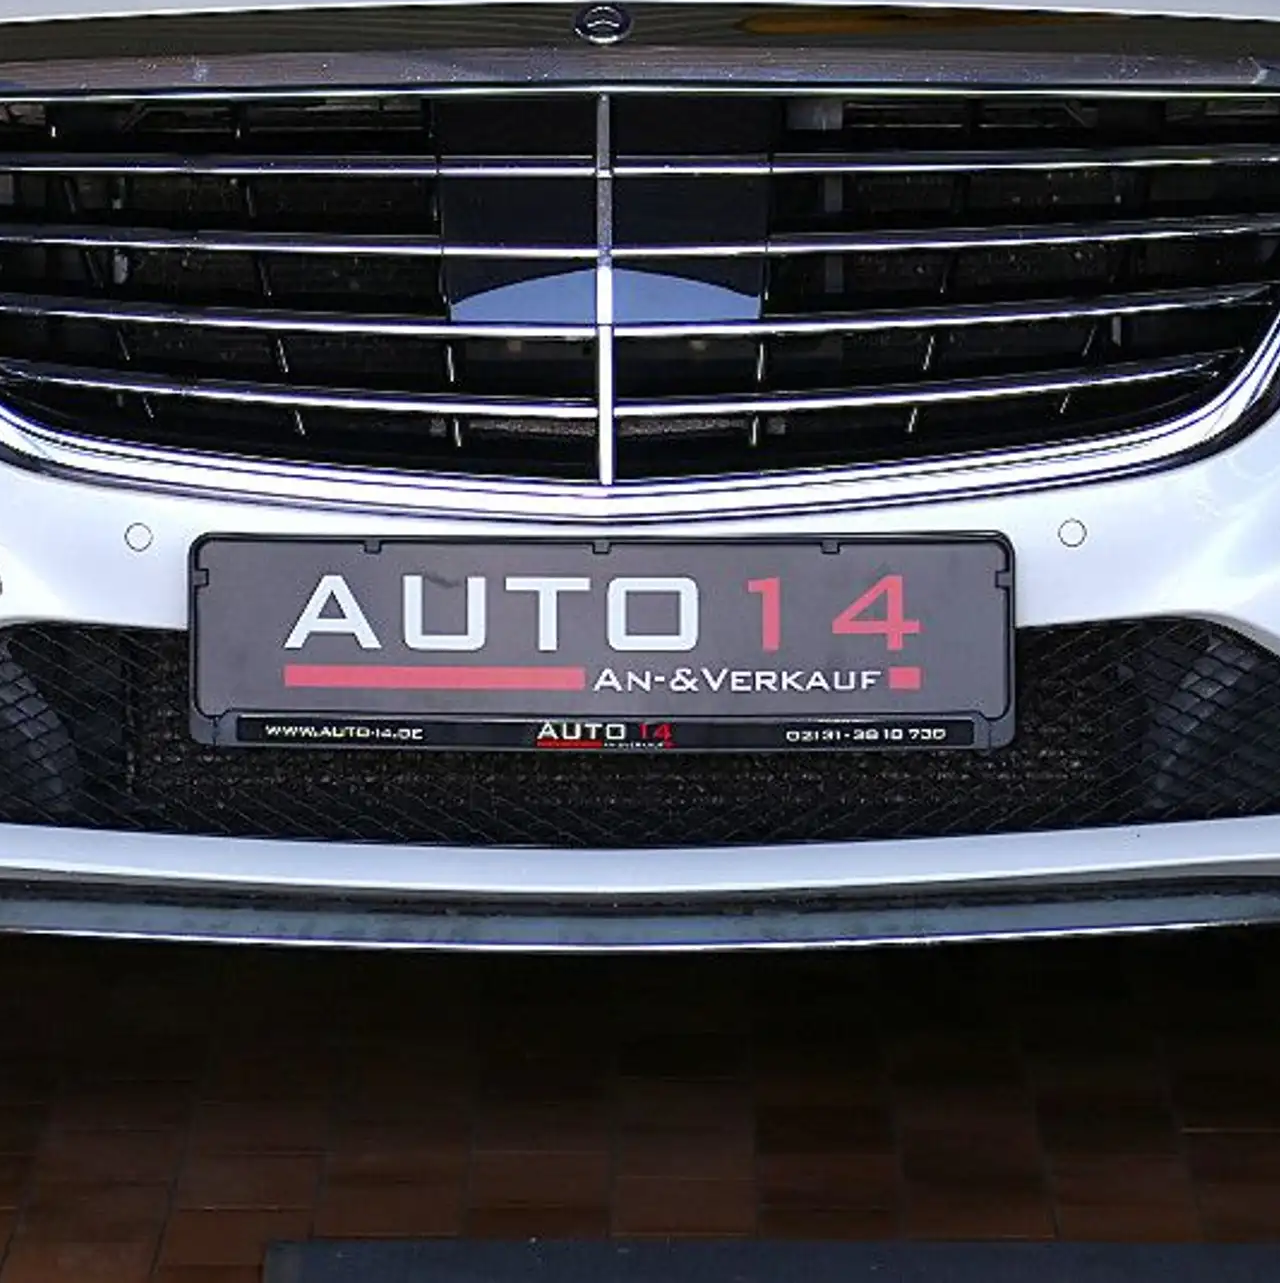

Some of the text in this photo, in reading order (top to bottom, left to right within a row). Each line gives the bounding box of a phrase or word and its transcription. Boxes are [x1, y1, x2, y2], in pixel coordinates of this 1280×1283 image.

[284, 574, 921, 652] AUTO 14
[593, 667, 882, 692] AN-&VERKAUF
[537, 720, 673, 740] AUTO 14
